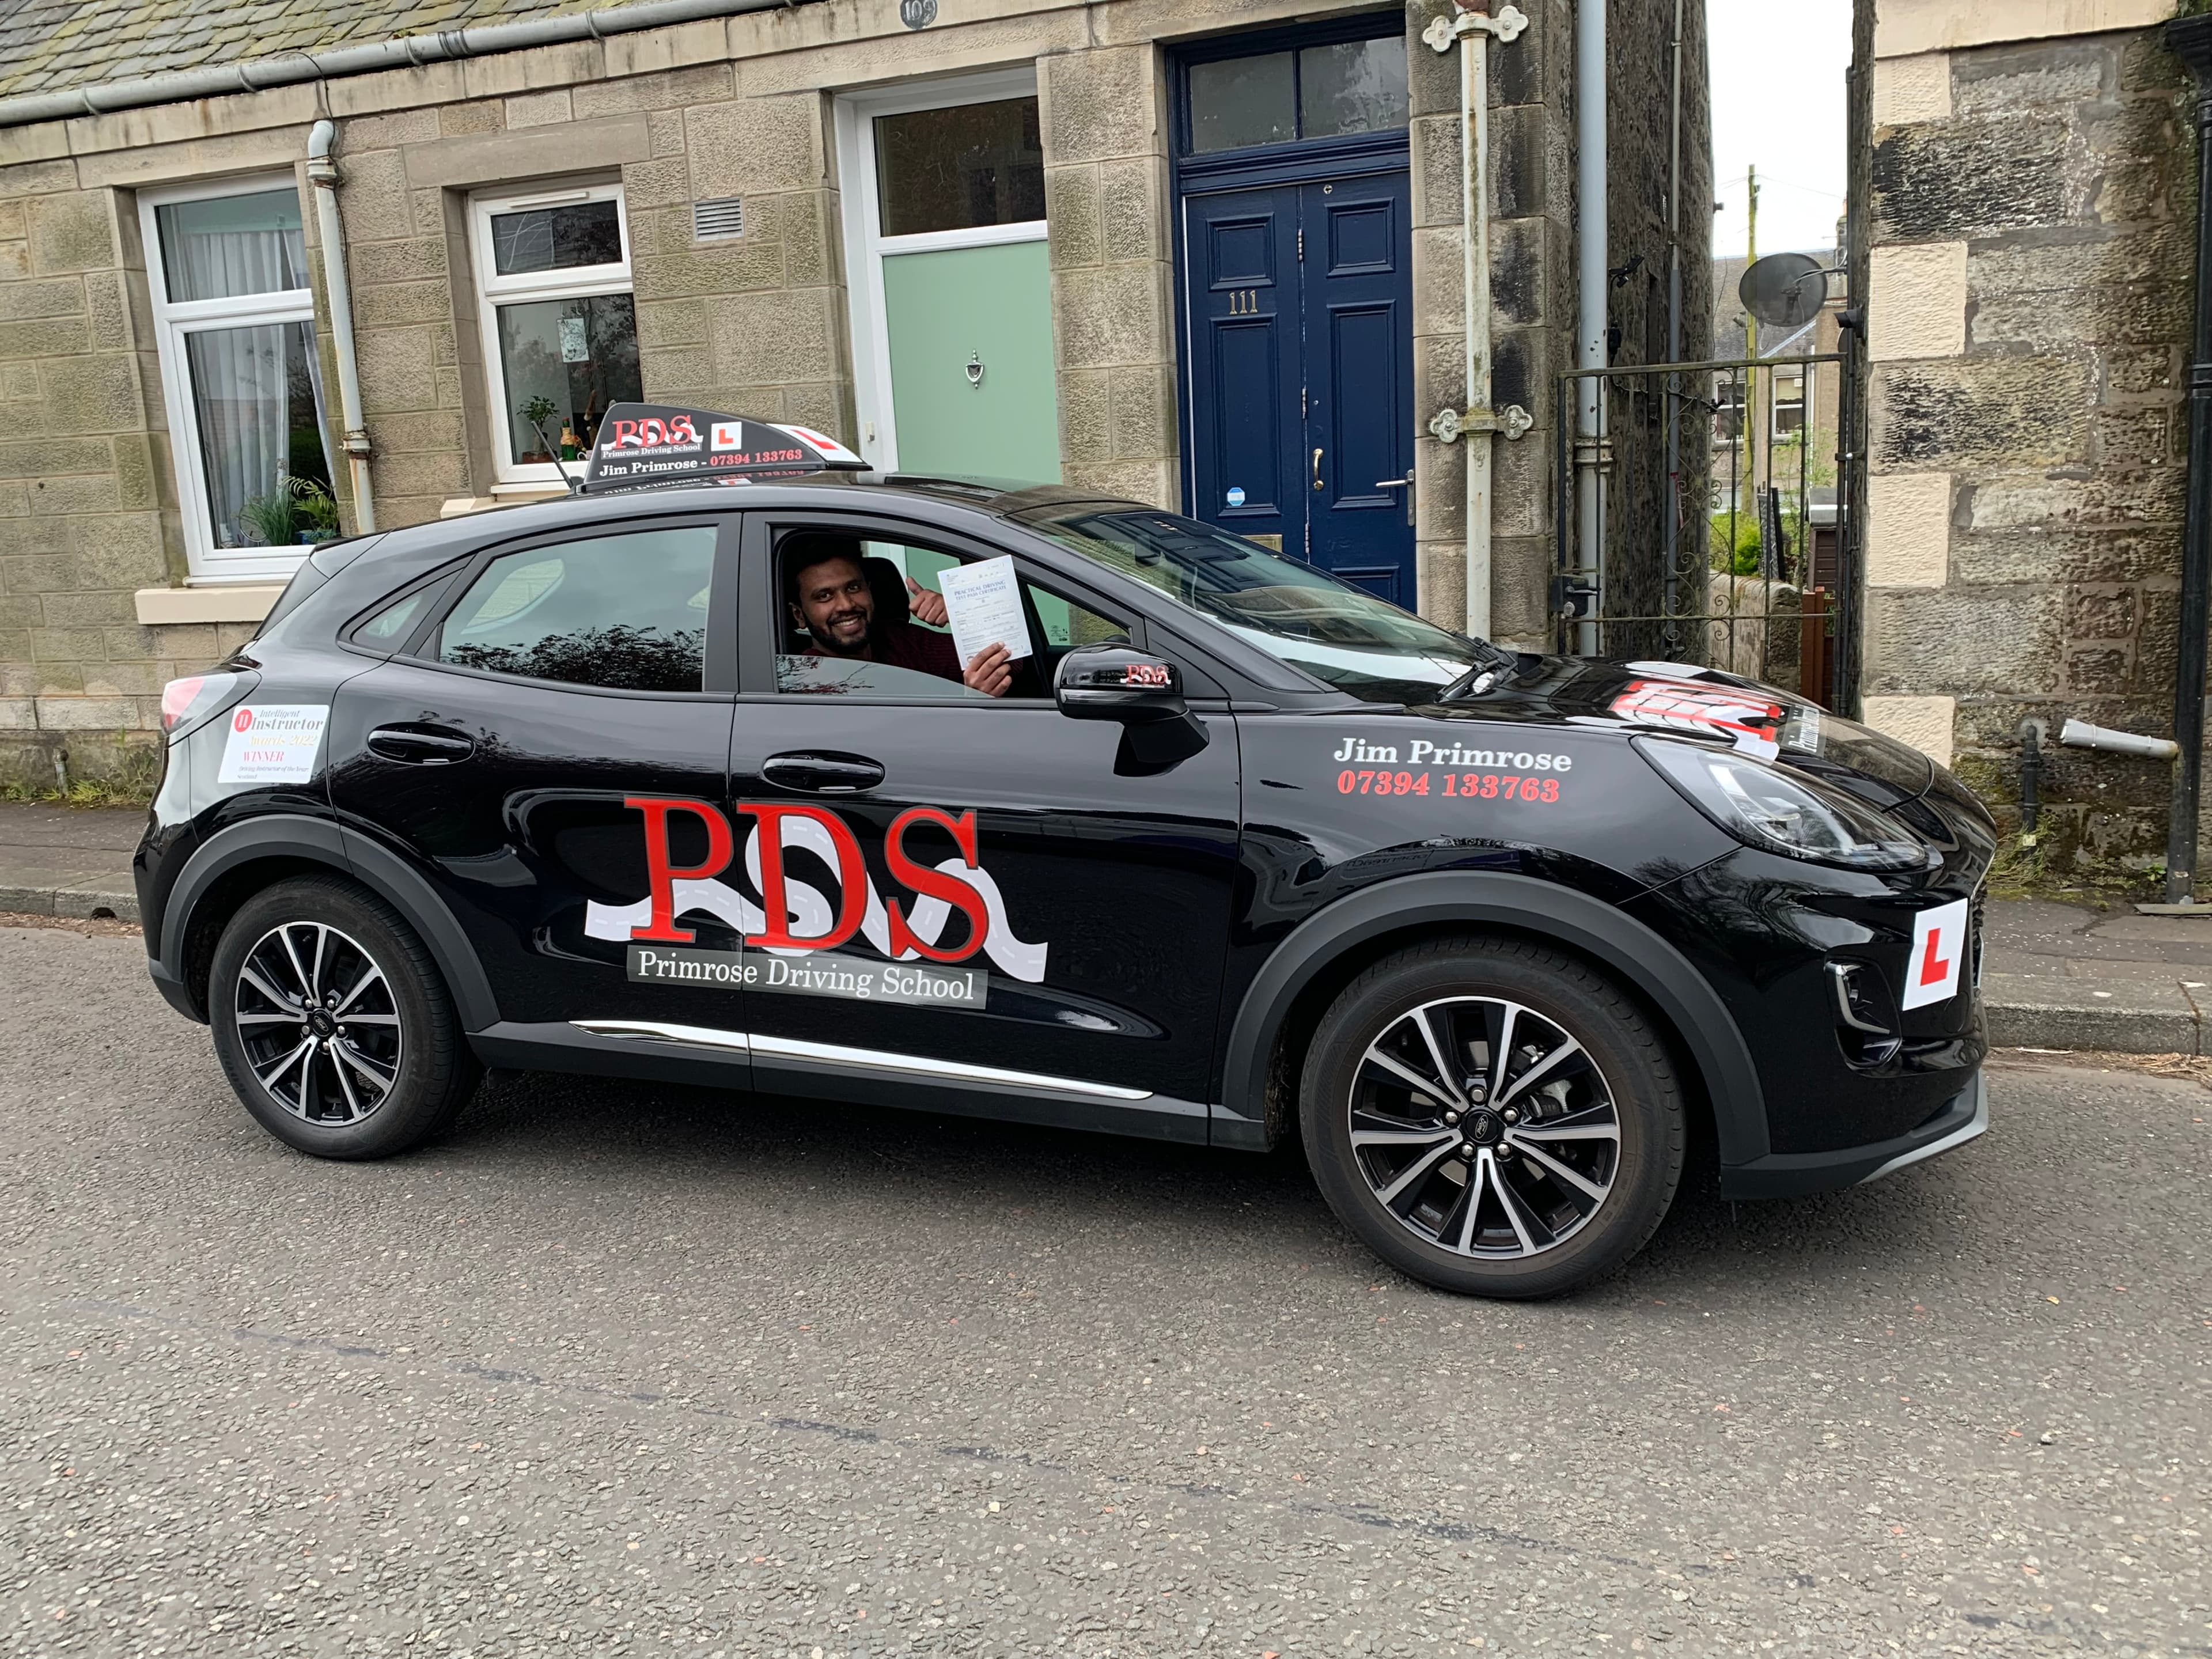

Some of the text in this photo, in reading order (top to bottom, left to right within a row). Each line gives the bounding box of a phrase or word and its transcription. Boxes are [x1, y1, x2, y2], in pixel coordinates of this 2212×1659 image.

[905, 0, 936, 21] 109
[1229, 290, 1258, 315] 111
[612, 415, 692, 450] PDS
[718, 429, 733, 444] L
[599, 465, 628, 476] Jim
[631, 460, 698, 474] Primrose
[710, 453, 750, 466] 07394
[755, 449, 803, 463] 133763
[603, 444, 700, 459] Primrose Driving School
[954, 579, 1006, 596] PRACTICAL DRIVING
[1125, 664, 1169, 684] PDS
[251, 717, 324, 730] Instructor
[260, 709, 300, 719] Intelligent
[244, 751, 284, 762] WINNER
[1334, 737, 1573, 772] Jim Primrose
[1337, 769, 1560, 803] 07394 133763
[623, 794, 990, 963] PDS
[1919, 927, 1950, 987] L
[638, 950, 974, 1000] Primrose Driving School
